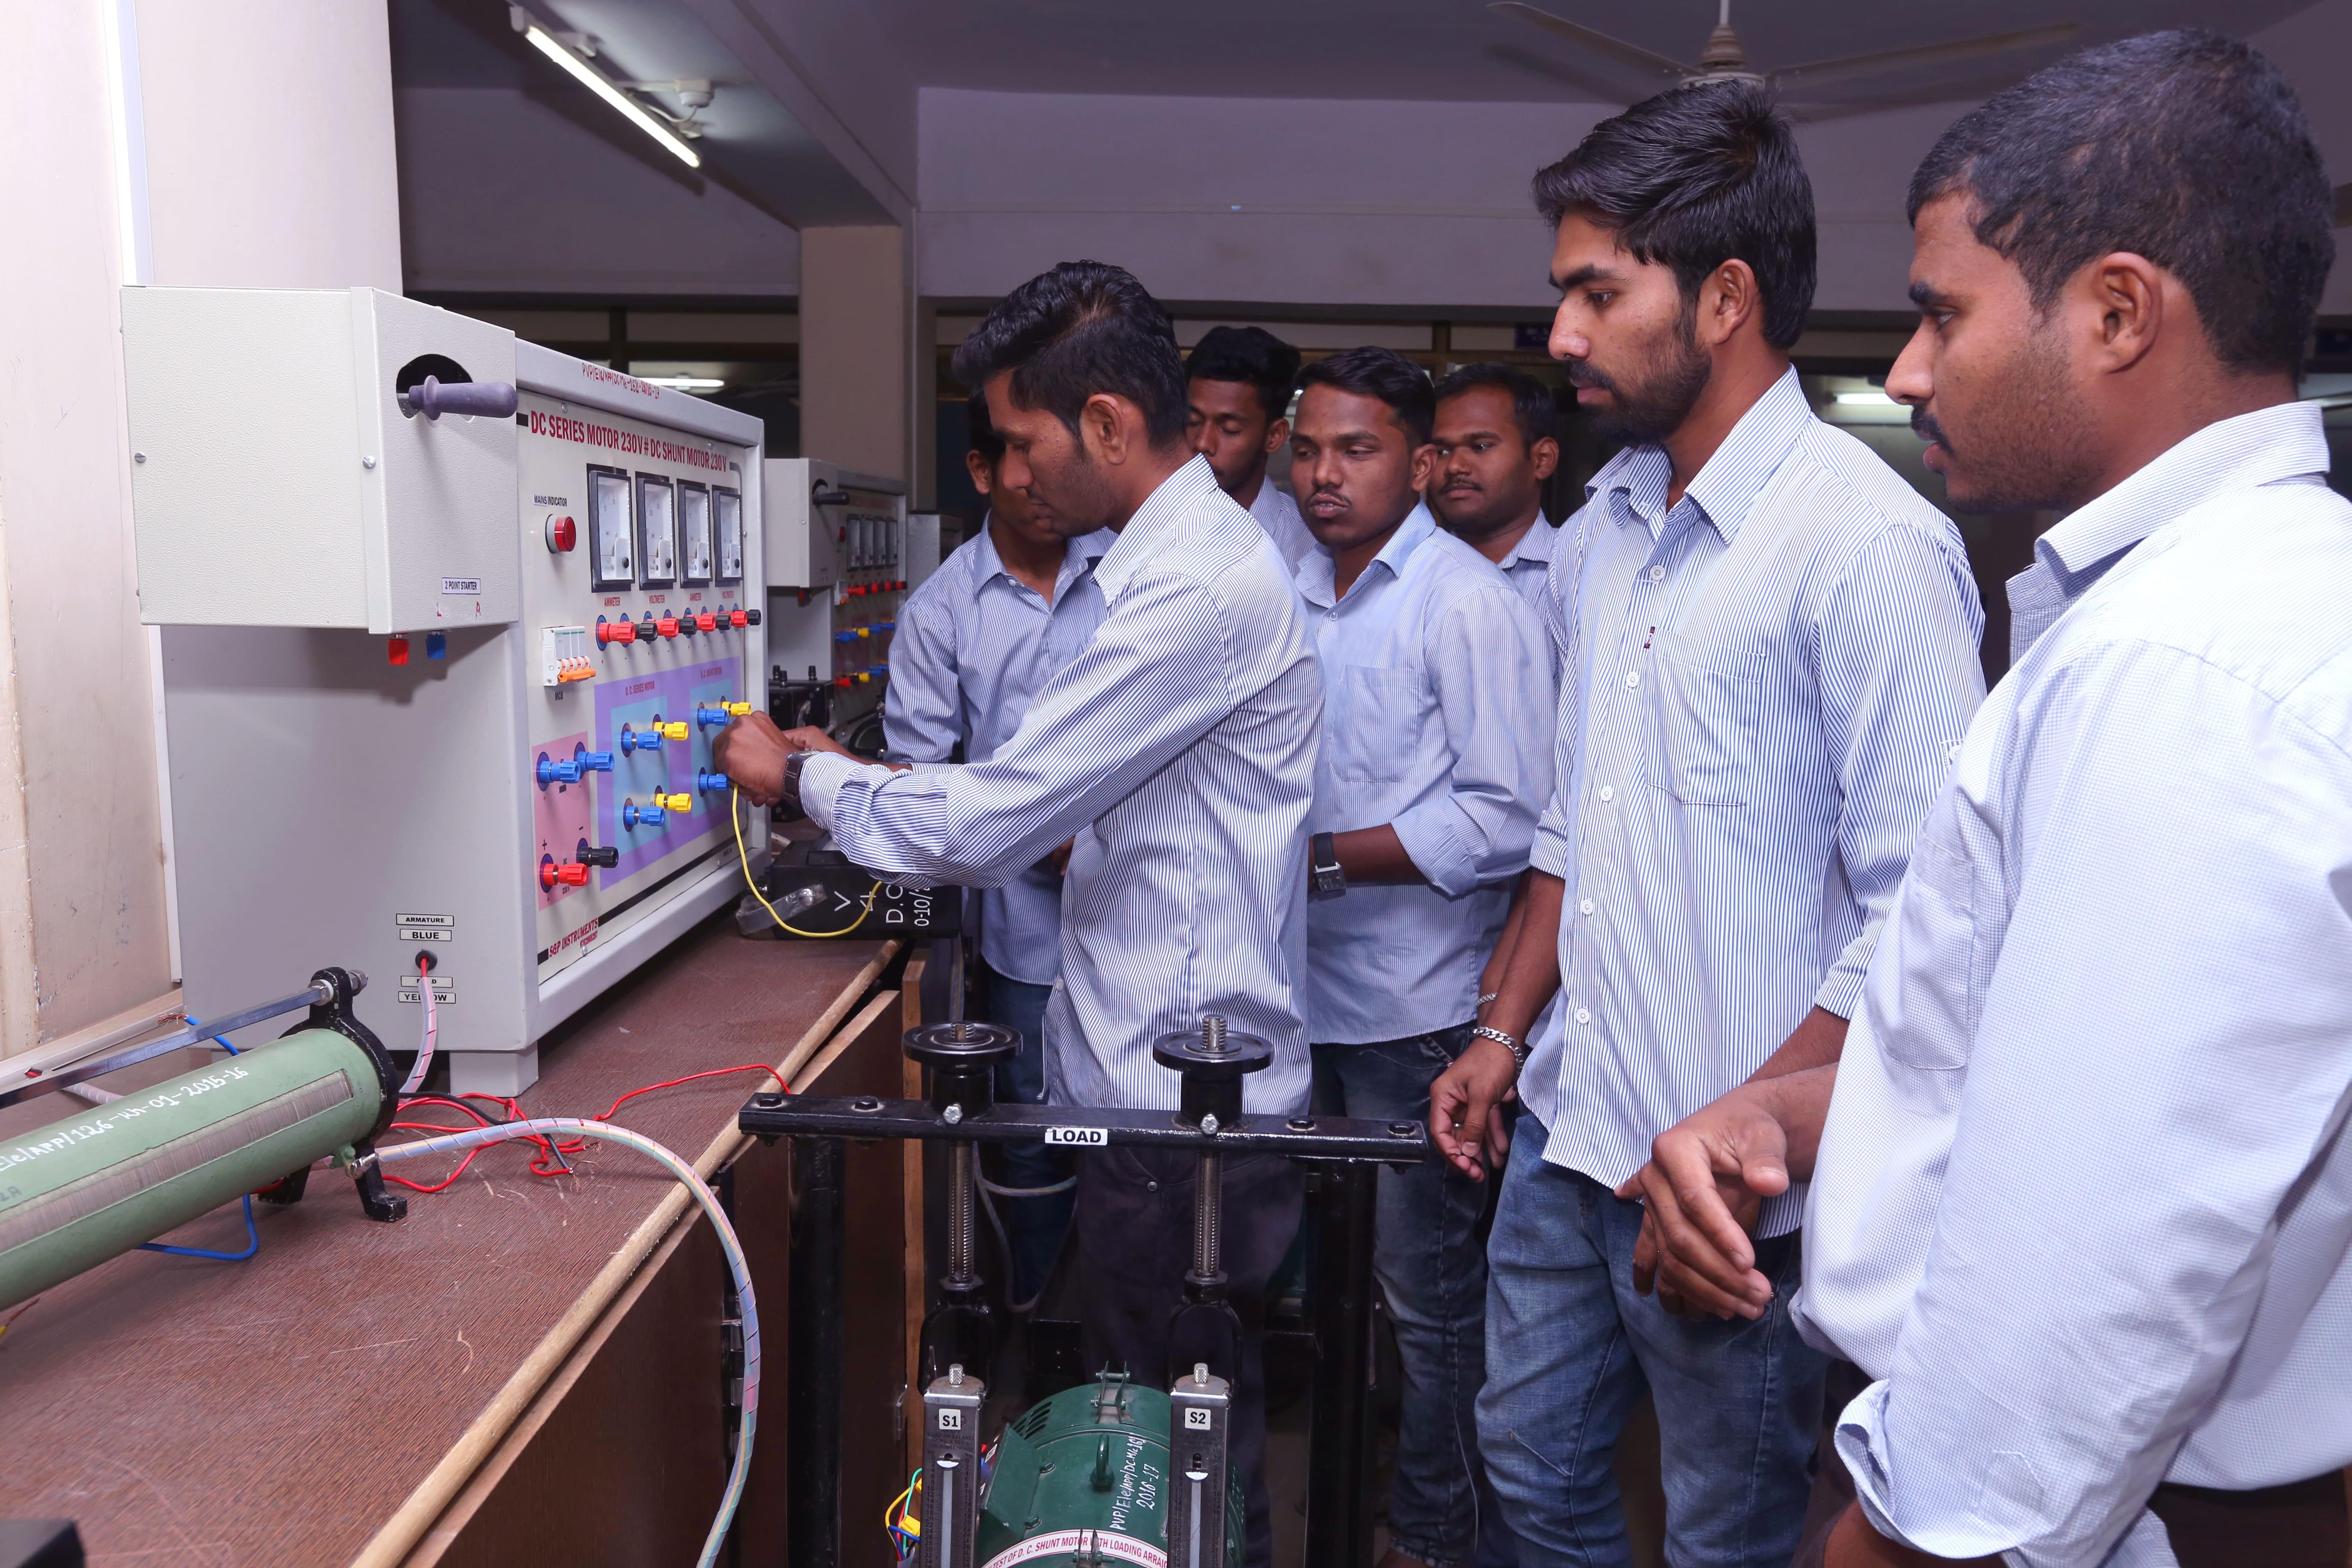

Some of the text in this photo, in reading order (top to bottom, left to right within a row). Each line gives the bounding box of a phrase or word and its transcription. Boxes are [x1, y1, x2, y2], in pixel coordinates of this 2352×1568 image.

[531, 410, 546, 435] DC
[549, 415, 585, 443] SERIES
[587, 423, 619, 450] MOTOR
[621, 432, 643, 454] 230V
[651, 438, 661, 459] DC
[663, 441, 685, 464] SHUNT
[687, 447, 709, 469] MOTOR
[534, 495, 547, 505] MAINS
[445, 581, 477, 590] 2 POINT STARTER
[604, 597, 621, 607] AMMETER
[649, 595, 665, 604] VOLTMETER
[633, 683, 644, 694] SERIES
[644, 681, 655, 692] MOTOR
[555, 691, 563, 701] MCB
[562, 917, 598, 950] INSTRUMENTS
[1053, 1130, 1101, 1143] LOAD
[943, 1415, 958, 1427] S1
[1190, 1412, 1206, 1424] S2
[1136, 1464, 1159, 1510] 2016-17
[993, 1556, 1007, 1568] TEST
[1008, 1551, 1018, 1562] OF
[1018, 1549, 1024, 1558] D.
[1027, 1545, 1033, 1554] C.
[1035, 1538, 1060, 1552] SHUNT
[1062, 1537, 1088, 1547] MOTOR
[1110, 1539, 1142, 1557] LOADING
